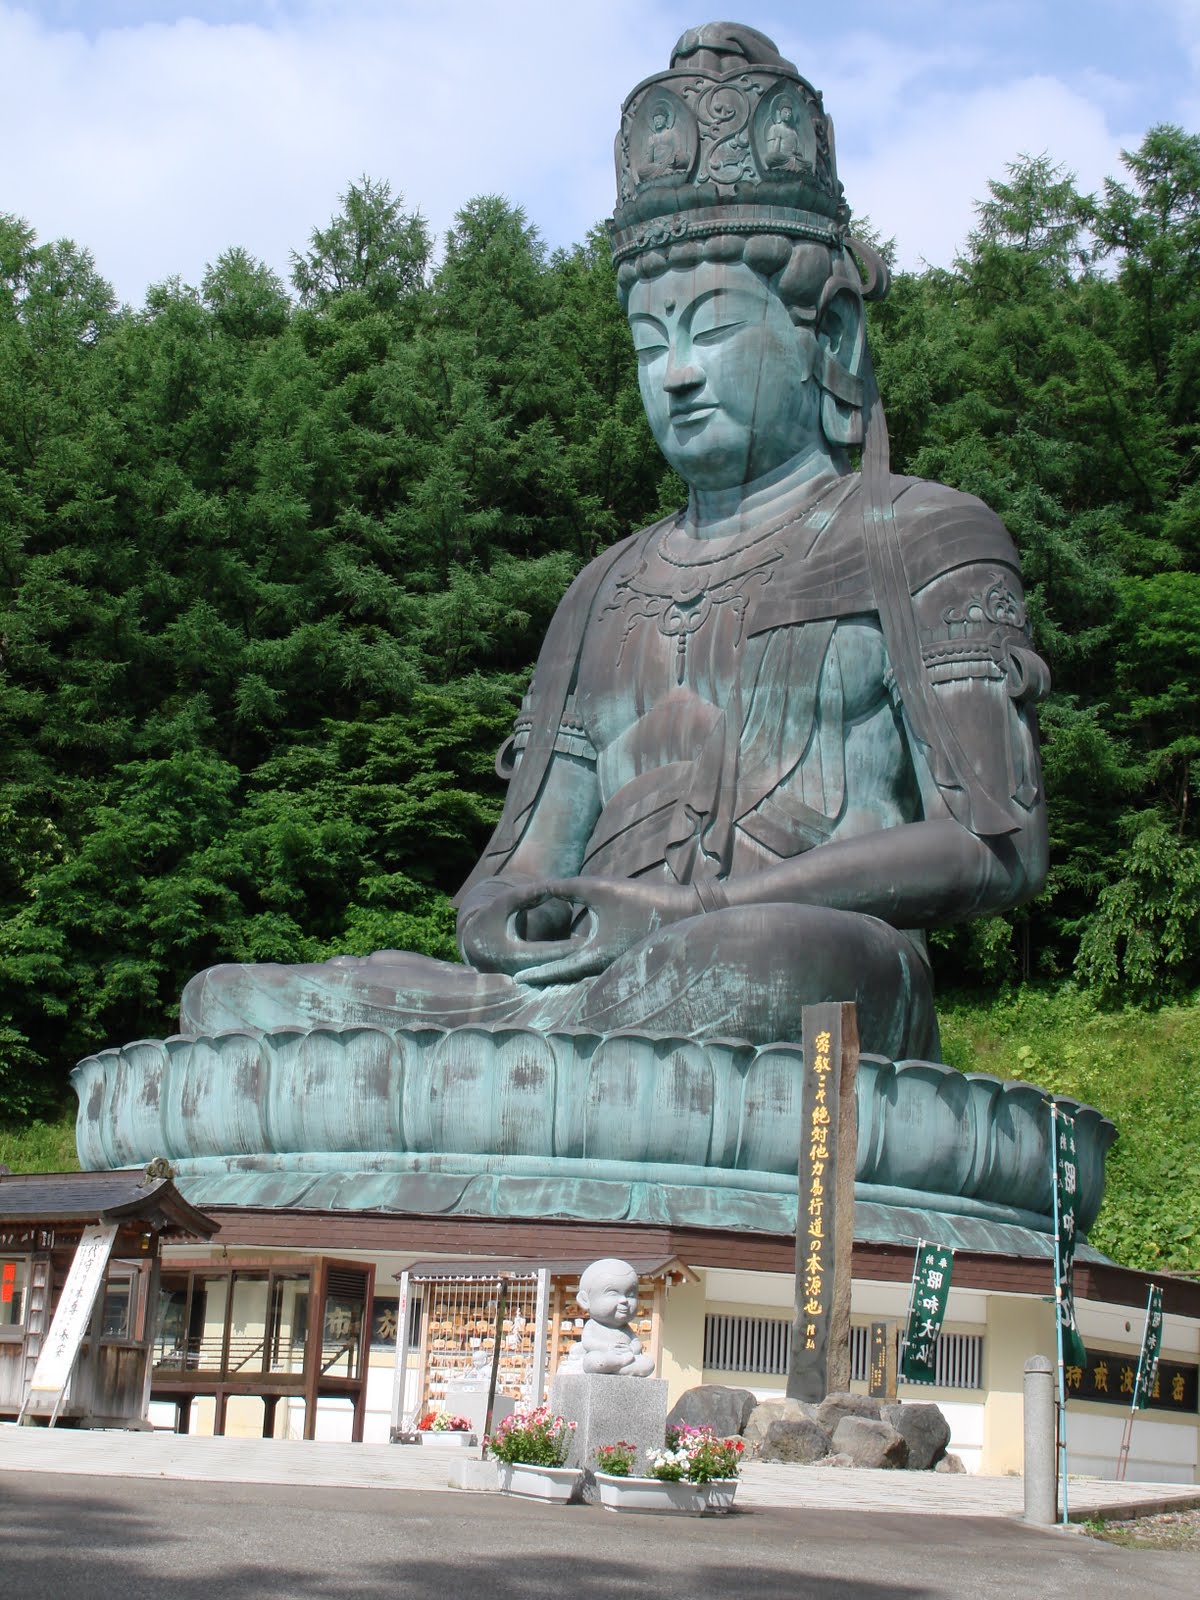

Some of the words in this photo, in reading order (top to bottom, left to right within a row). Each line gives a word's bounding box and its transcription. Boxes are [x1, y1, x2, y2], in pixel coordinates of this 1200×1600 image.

[804, 1030, 831, 1315] 密教こそ絶対他力易行道の本源也
